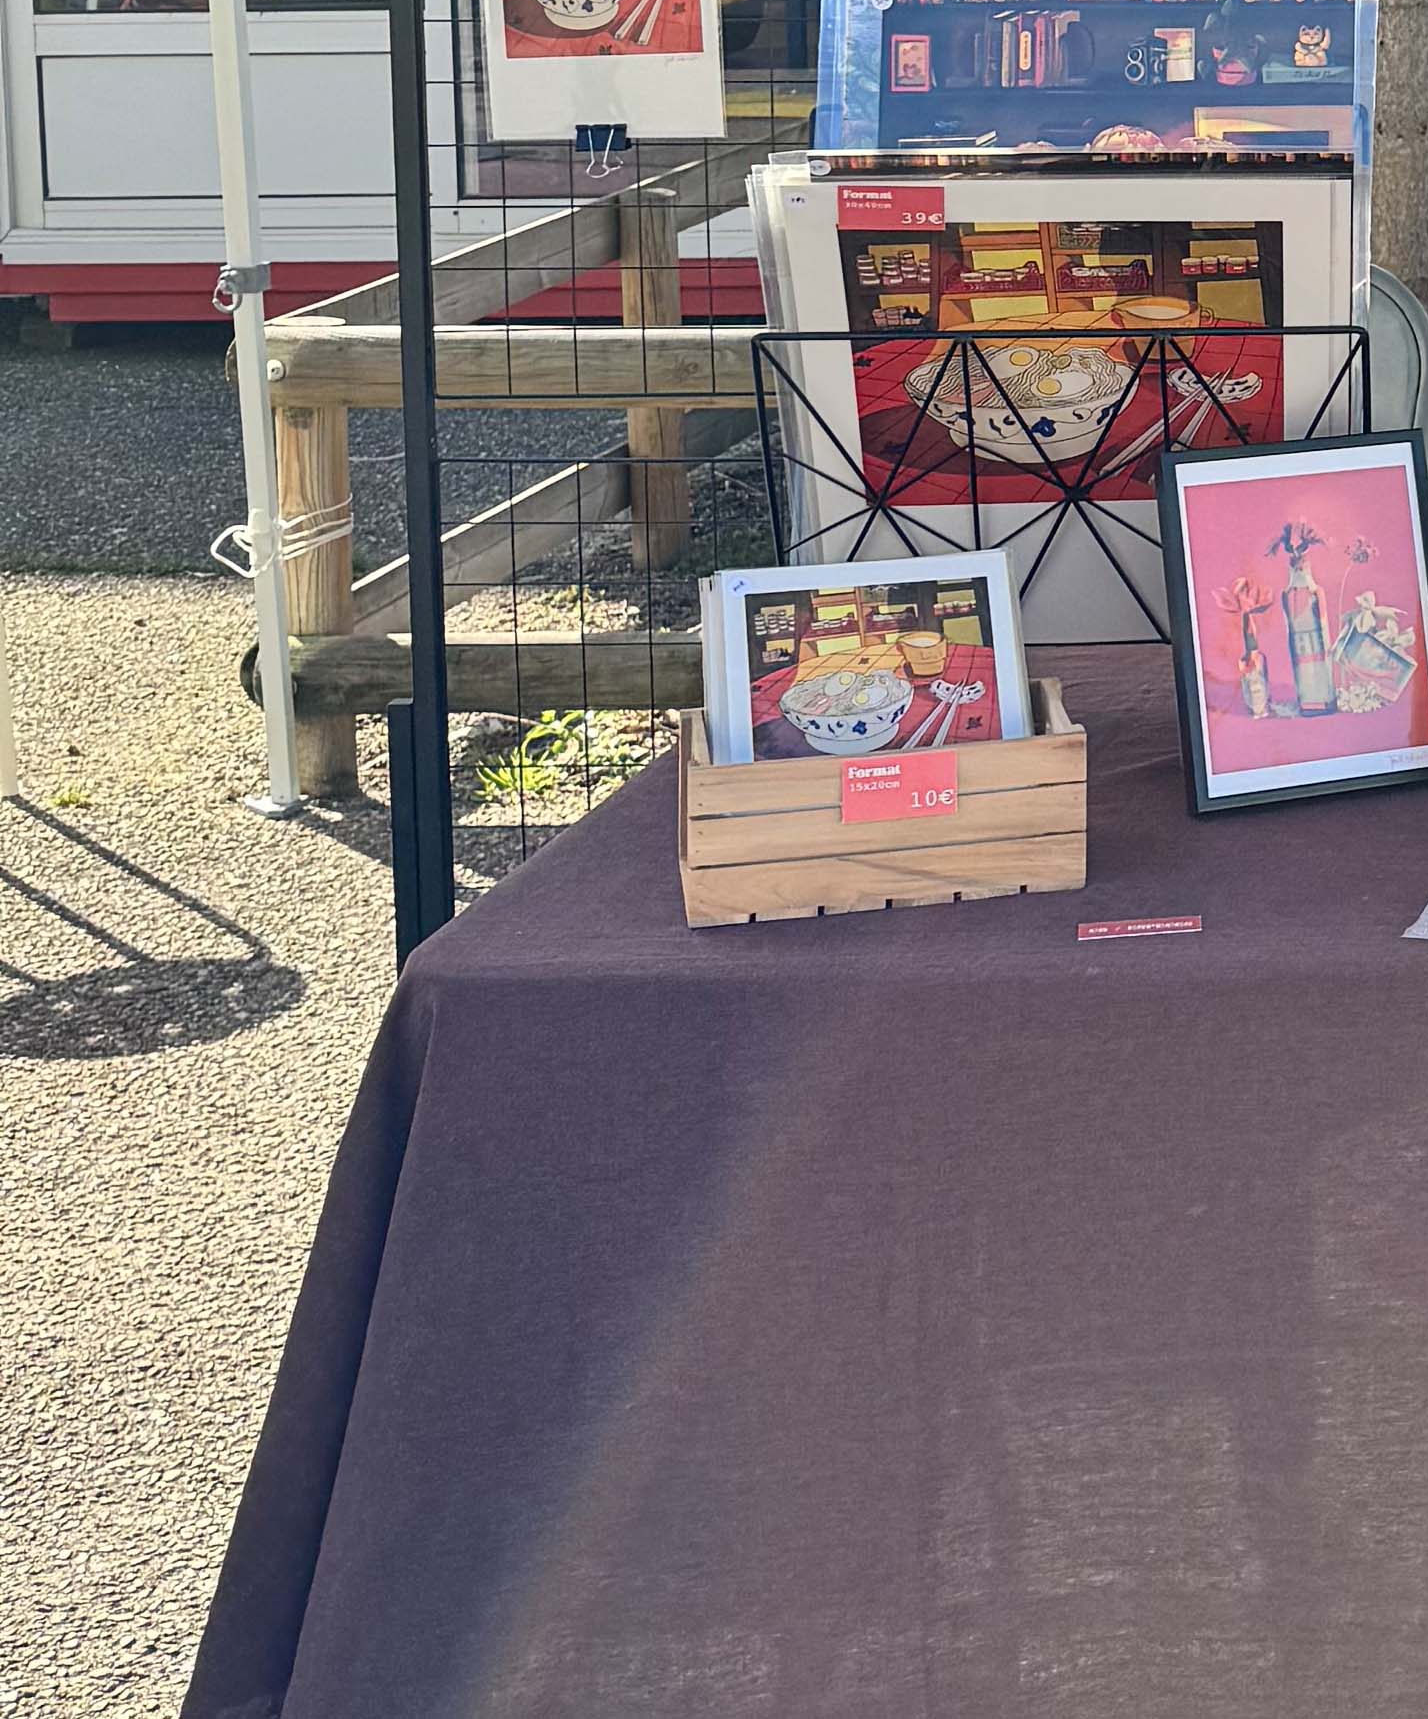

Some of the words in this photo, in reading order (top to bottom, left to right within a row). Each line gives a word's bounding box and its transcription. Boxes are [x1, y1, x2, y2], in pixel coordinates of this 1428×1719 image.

[843, 190, 893, 200] Format
[901, 212, 943, 224] 39€
[847, 764, 901, 779] Format
[849, 780, 901, 793] 15x20cm
[911, 789, 954, 808] 10€
